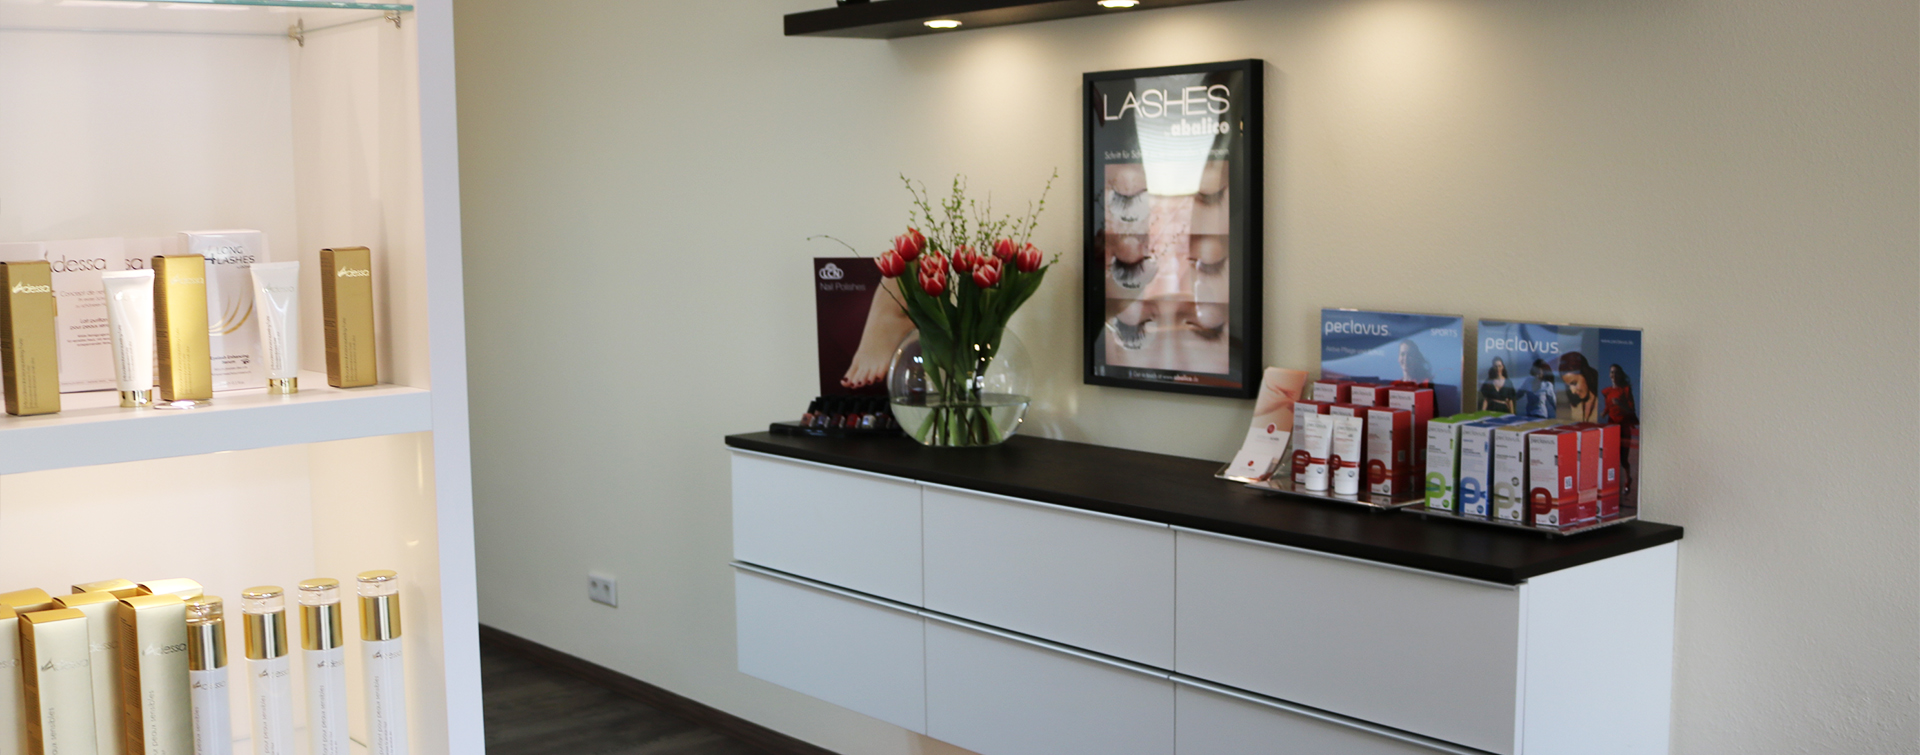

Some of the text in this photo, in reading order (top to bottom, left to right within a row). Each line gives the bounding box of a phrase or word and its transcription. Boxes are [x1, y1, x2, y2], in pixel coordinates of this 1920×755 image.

[1104, 84, 1230, 120] LASHES
[1171, 117, 1230, 136] abalico
[216, 255, 255, 265] LASHES
[338, 266, 369, 277] Adessa
[12, 281, 50, 293] Adessa
[819, 282, 866, 291] Nail Polishes
[1325, 319, 1390, 337] peclavus
[1485, 335, 1560, 354] peclavus
[147, 690, 157, 722] sensibles
